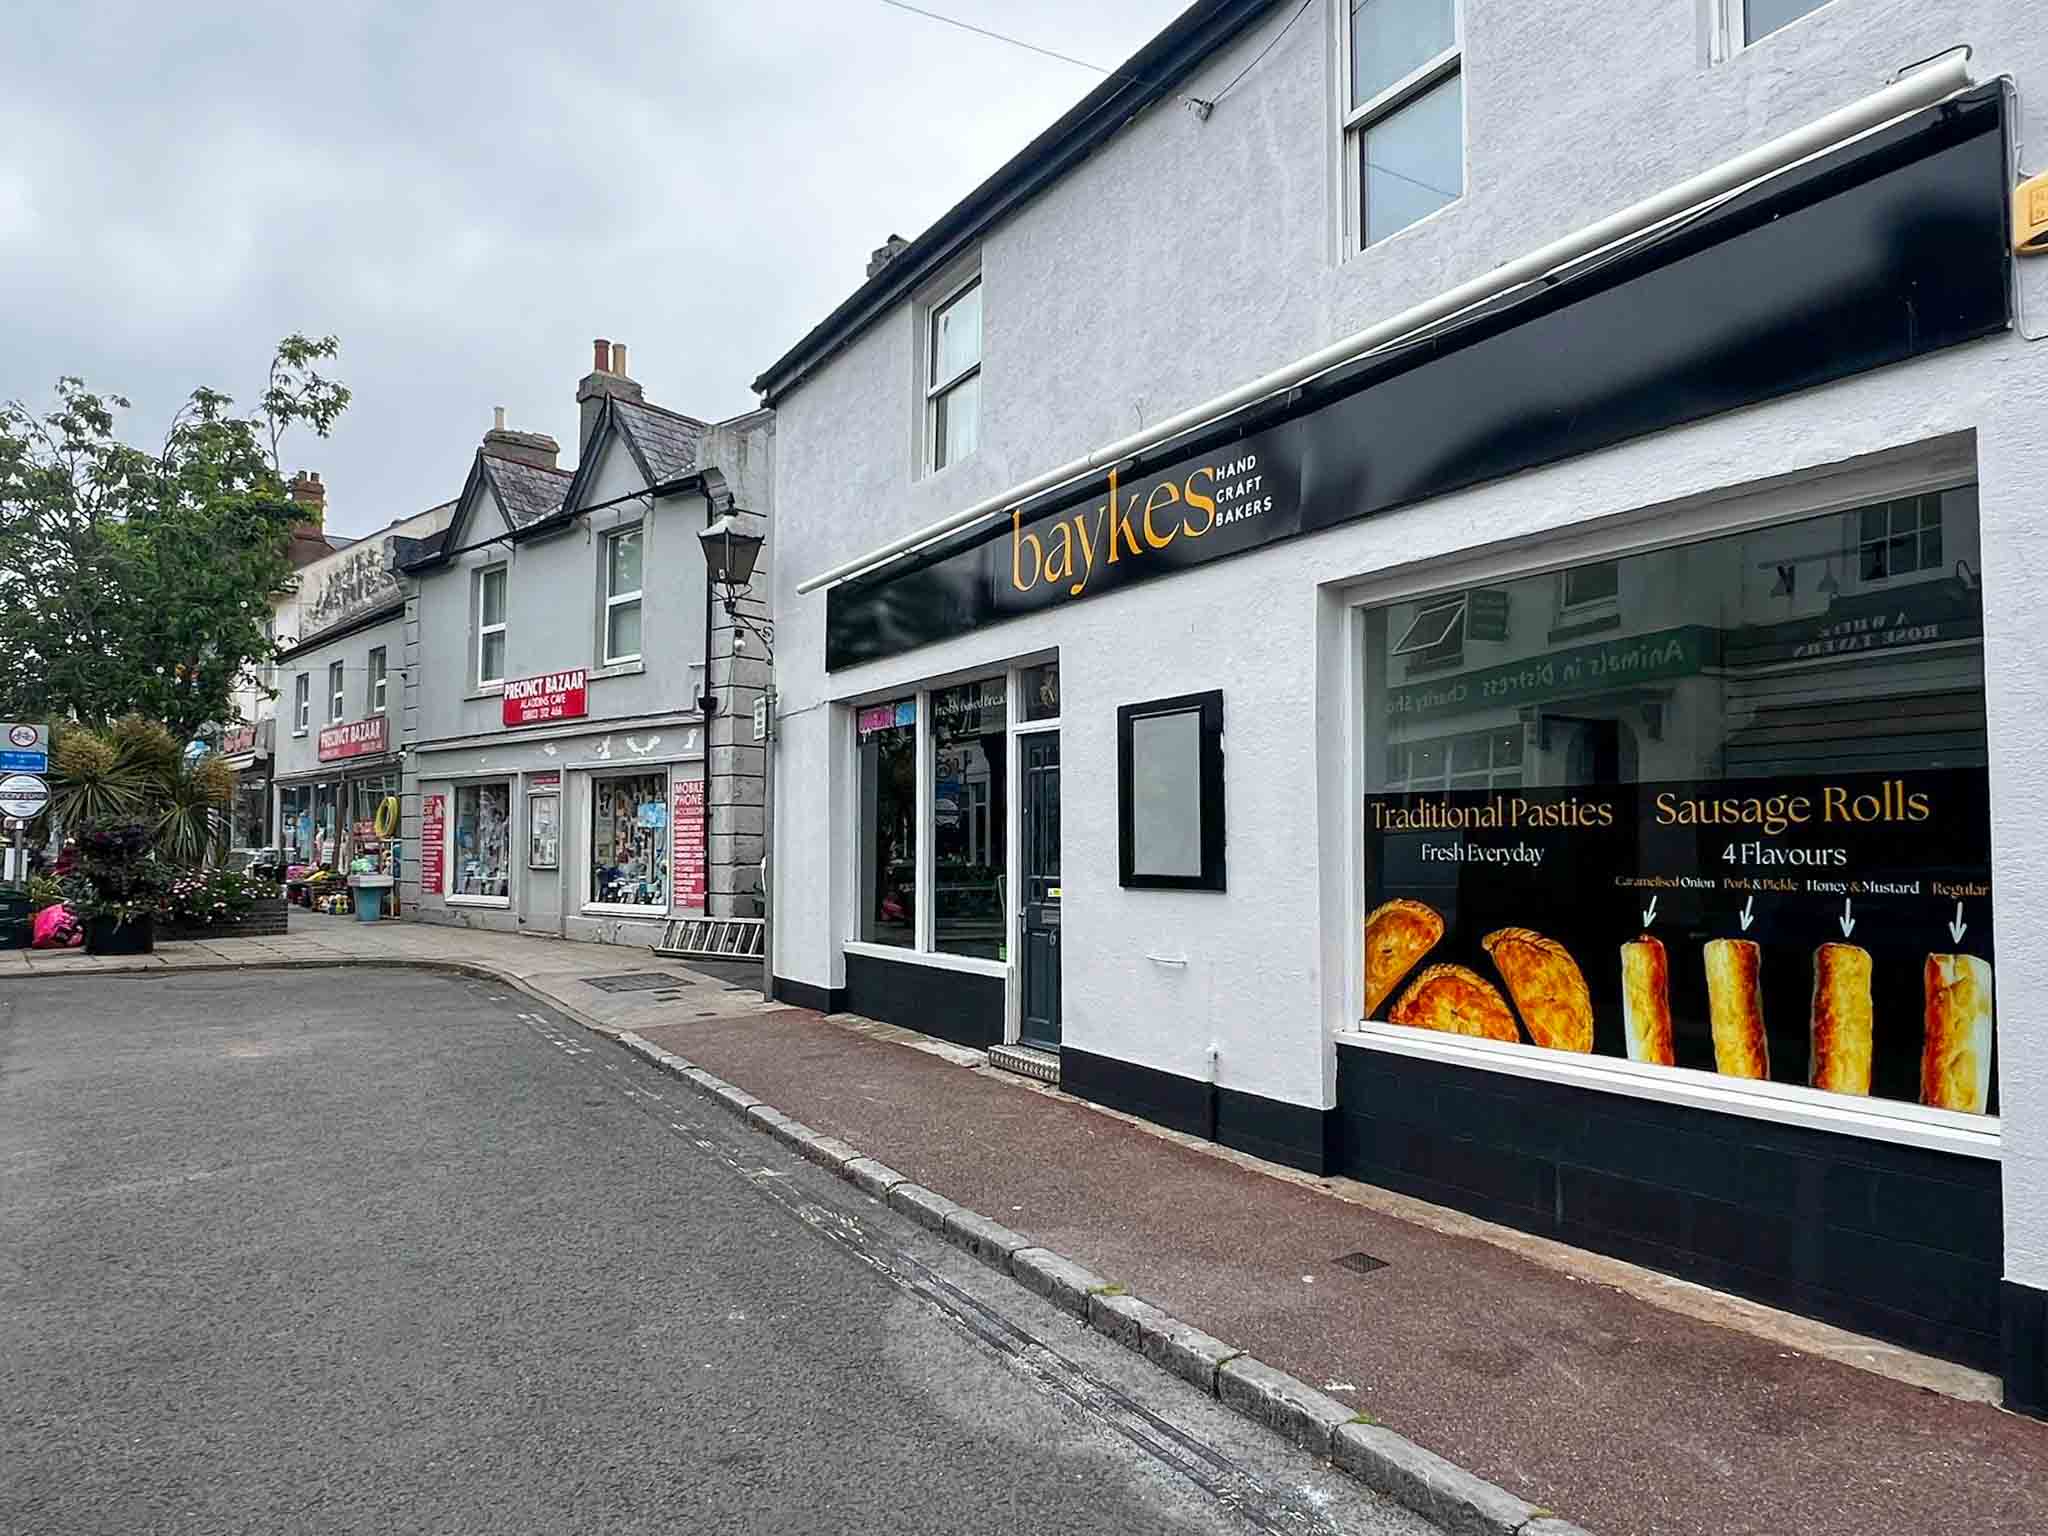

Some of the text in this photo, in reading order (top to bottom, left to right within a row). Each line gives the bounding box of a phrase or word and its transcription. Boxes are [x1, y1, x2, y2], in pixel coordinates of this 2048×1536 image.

[1216, 455, 1256, 481] HAND
[1216, 476, 1262, 504] CRAFT
[1216, 496, 1273, 527] BAKERS
[1012, 467, 1217, 596] baykes
[504, 671, 584, 700] PRECINCT BAZAAR
[550, 693, 566, 705] CAVE
[351, 720, 381, 744] BAZAAR
[674, 782, 704, 794] MOBILE
[1371, 796, 1613, 829] Traditional Pasties
[1656, 780, 1929, 835] Sausage Rolls
[1421, 842, 1545, 867] Fresh Everyday
[1721, 842, 1848, 866] 4 Flavours
[1680, 876, 1716, 889] Onion
[1723, 878, 1800, 891] Pork & Pickle
[1806, 880, 1920, 895] Honey & Mustard
[1932, 881, 1990, 899] Regular
